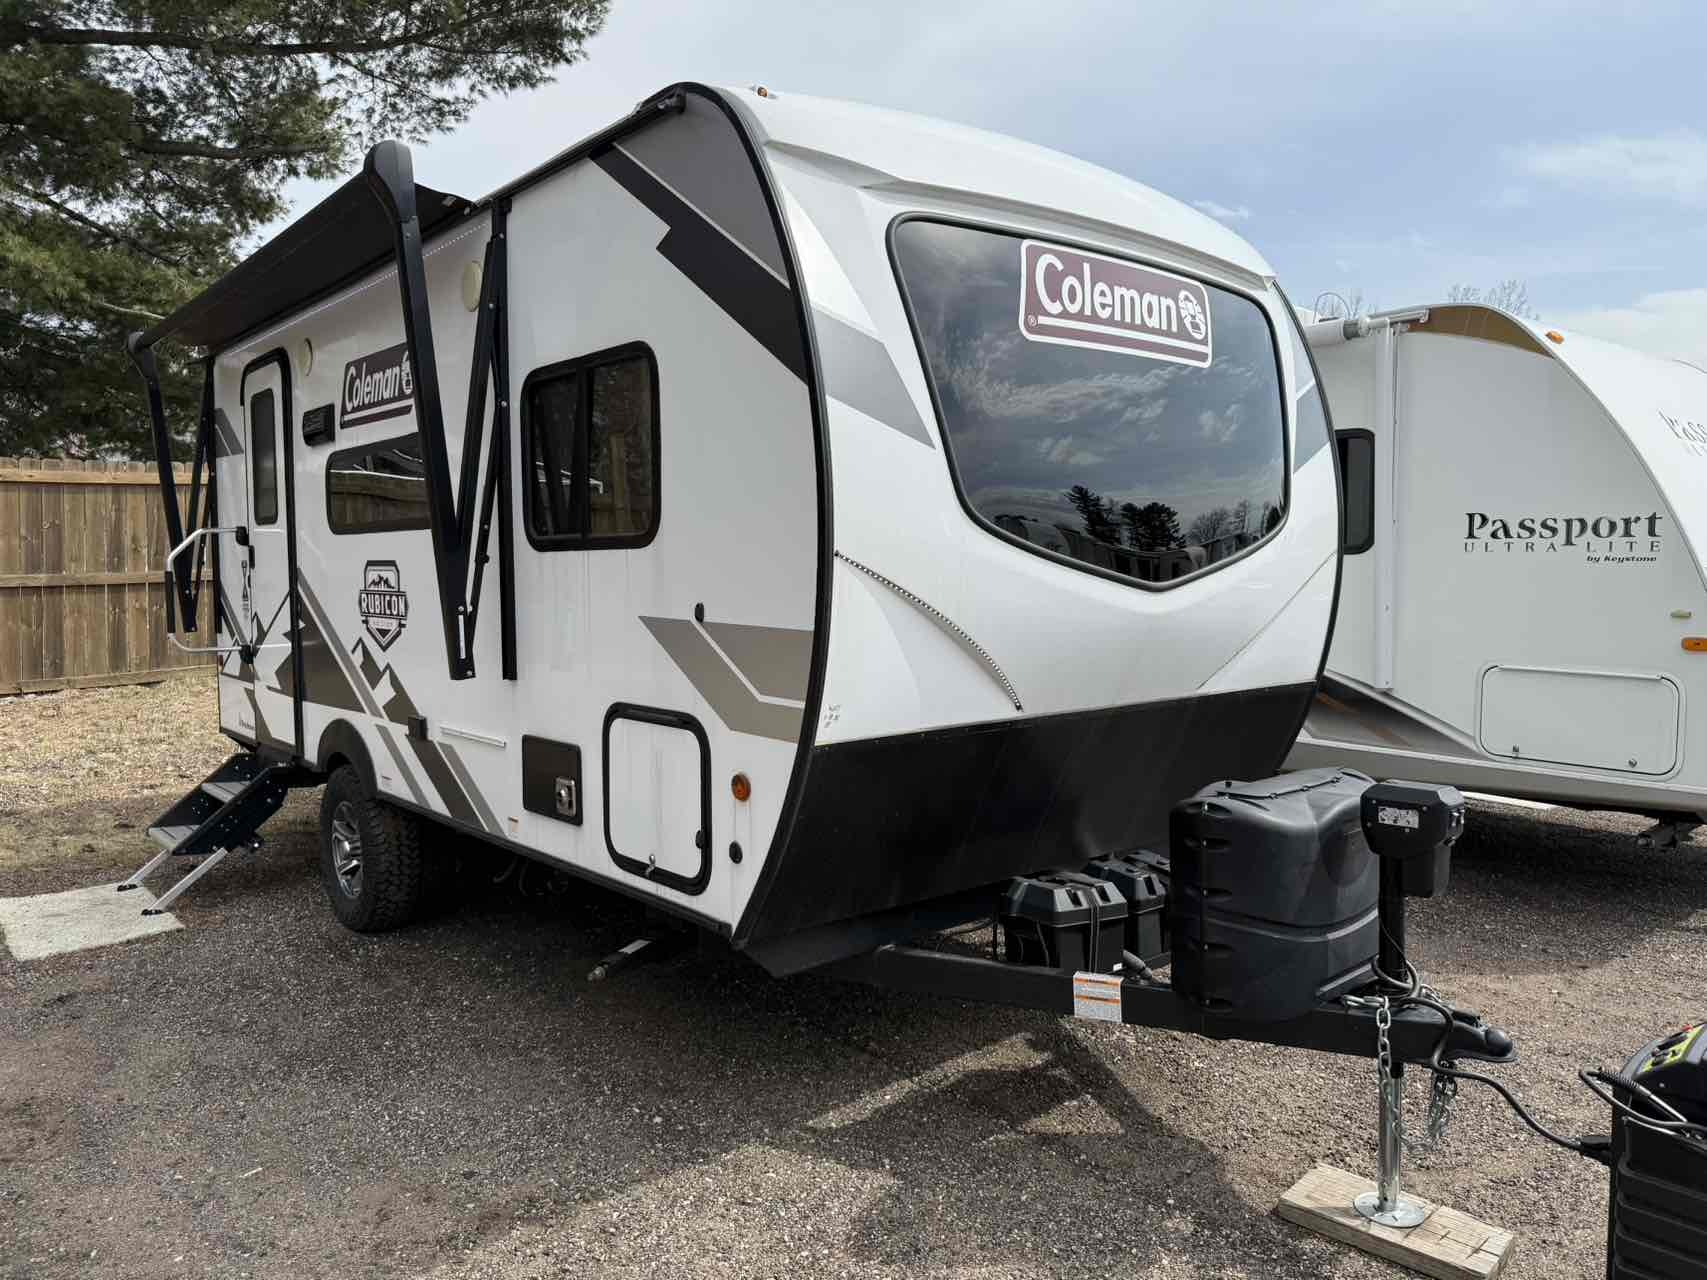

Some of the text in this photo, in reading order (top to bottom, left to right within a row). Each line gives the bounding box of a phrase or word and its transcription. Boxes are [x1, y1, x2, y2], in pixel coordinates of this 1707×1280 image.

[1035, 253, 1178, 333] Coleman
[344, 361, 401, 412] Coleman
[1464, 511, 1664, 546] Passport
[1464, 541, 1662, 553] ULTRA LITE
[1586, 554, 1658, 564] by Keystone
[361, 593, 406, 617] RUBICON
